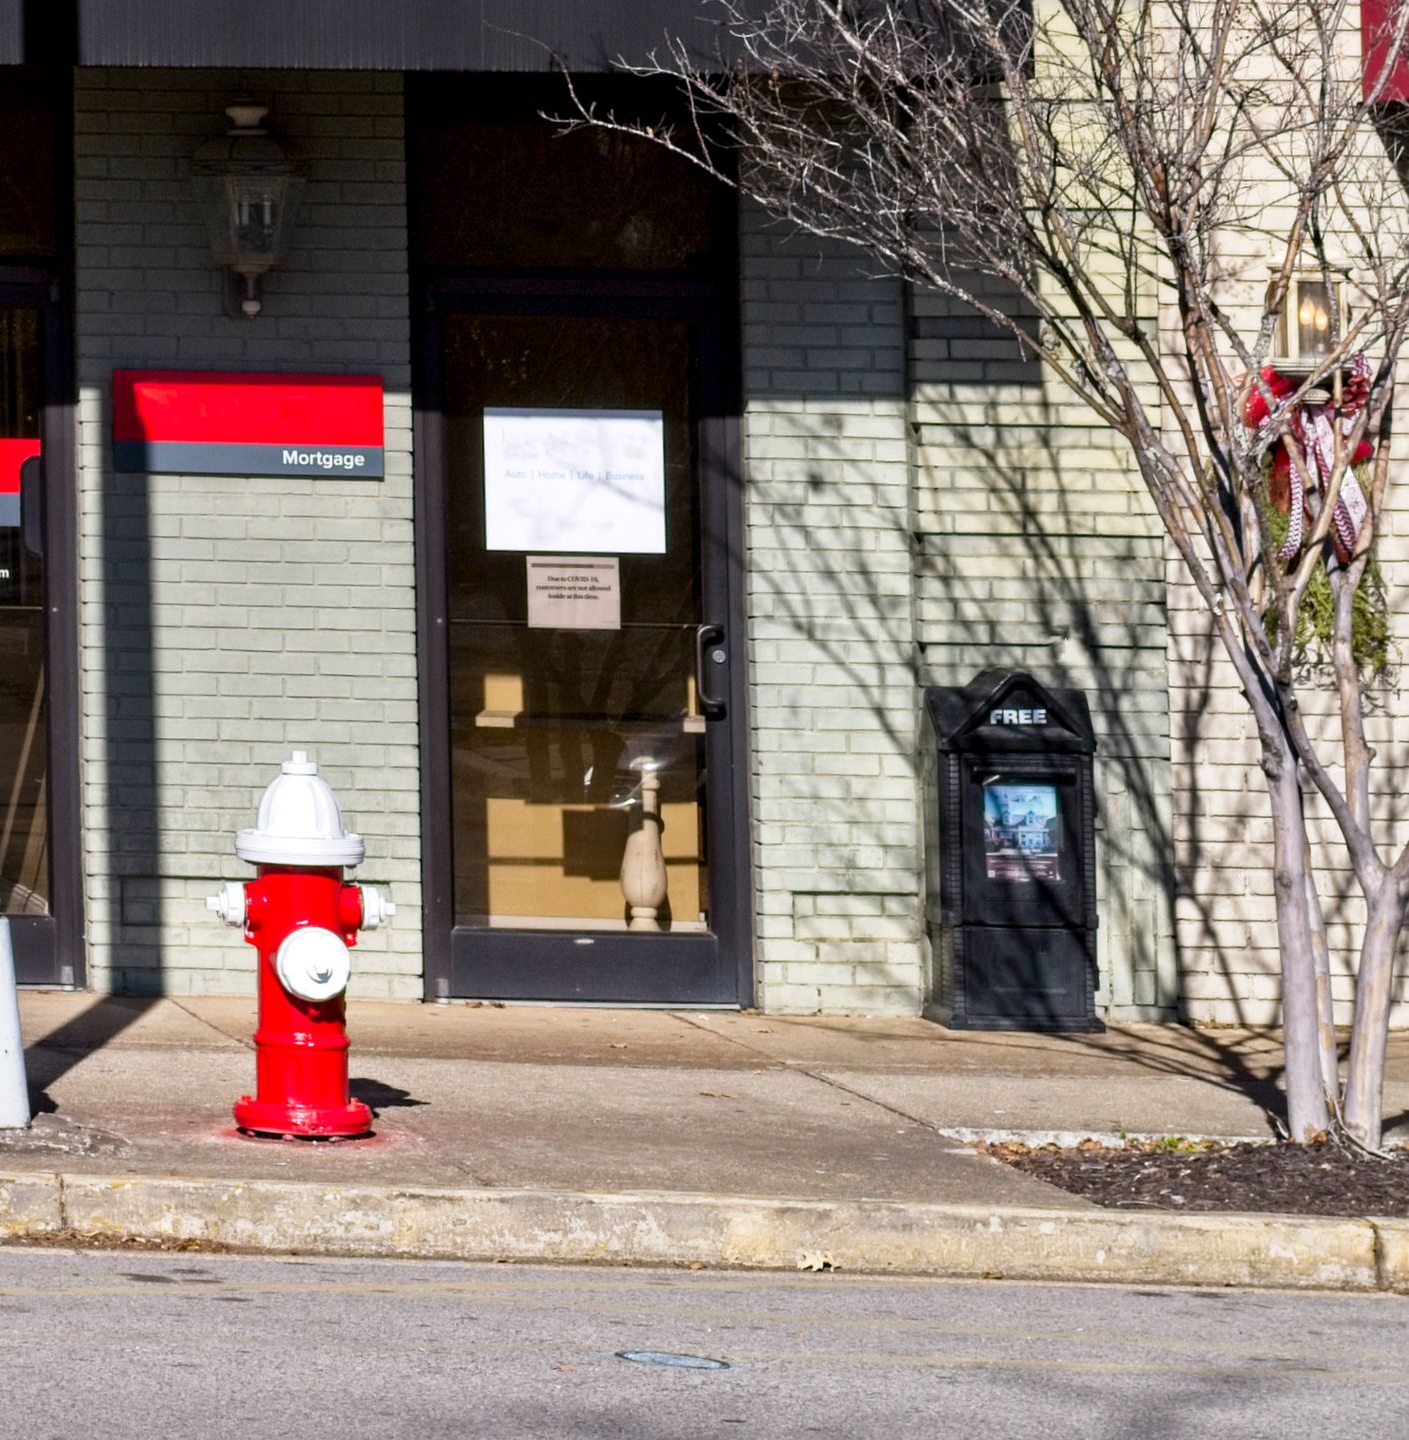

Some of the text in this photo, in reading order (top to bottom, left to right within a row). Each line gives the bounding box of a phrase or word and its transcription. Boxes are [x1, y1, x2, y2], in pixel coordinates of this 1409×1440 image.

[282, 450, 366, 469] Mortgage
[504, 468, 645, 482] Auto Home Life Business
[989, 708, 1047, 726] FREE
